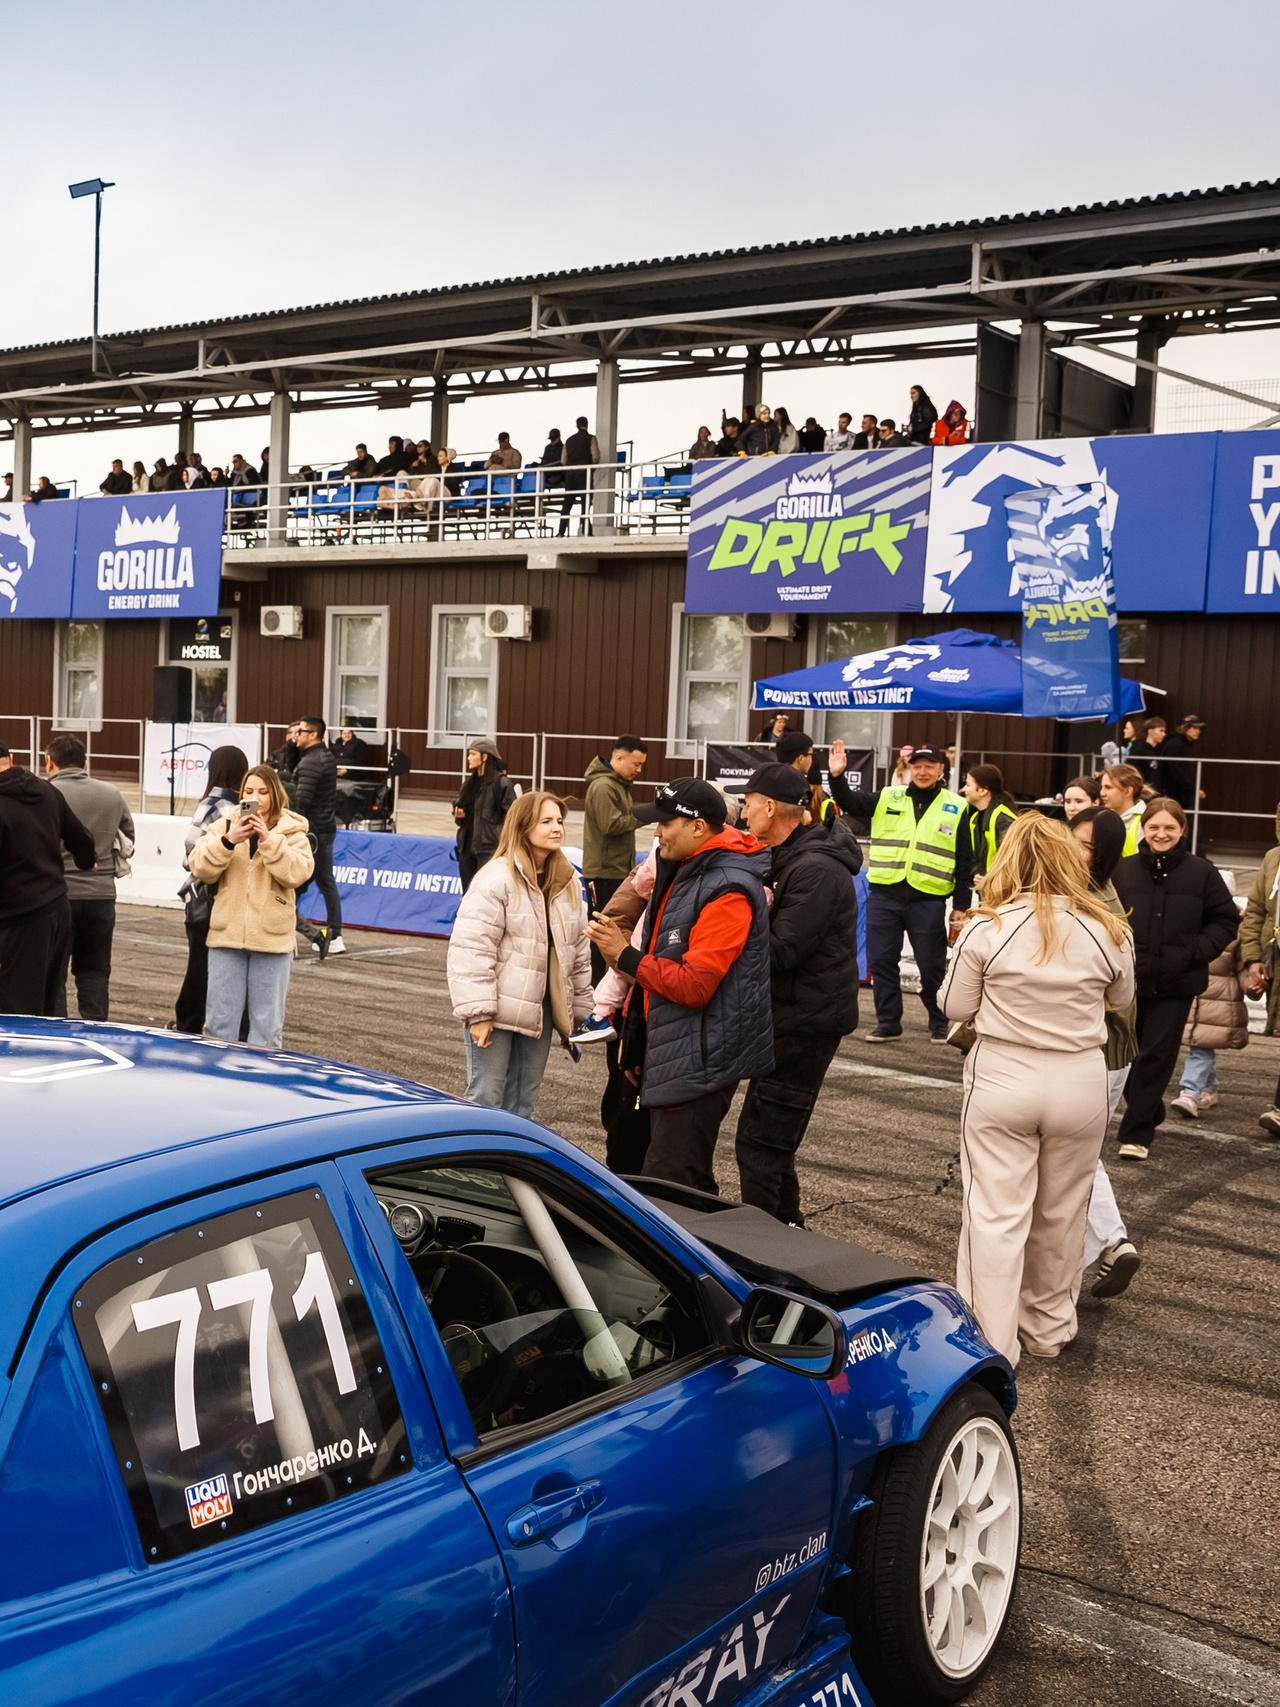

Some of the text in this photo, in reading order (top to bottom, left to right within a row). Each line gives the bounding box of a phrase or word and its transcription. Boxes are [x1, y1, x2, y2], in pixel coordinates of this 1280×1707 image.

[776, 494, 843, 520] GORILLA
[96, 547, 195, 591] GORILLA
[108, 594, 180, 610] ENERGY DRINK
[776, 585, 832, 594] ULTIMATE DRIFT
[779, 593, 829, 601] TOURNAMENT
[182, 645, 222, 659] HOSTEL
[763, 687, 914, 706] POWER YOUR INSTINCT
[372, 869, 412, 889] YOUR
[414, 873, 463, 895] INSTIN
[131, 1251, 358, 1452] 771
[232, 1427, 377, 1500] Гончаренко Д.
[187, 1475, 227, 1506] LIQUI
[191, 1495, 231, 1525] MOLY
